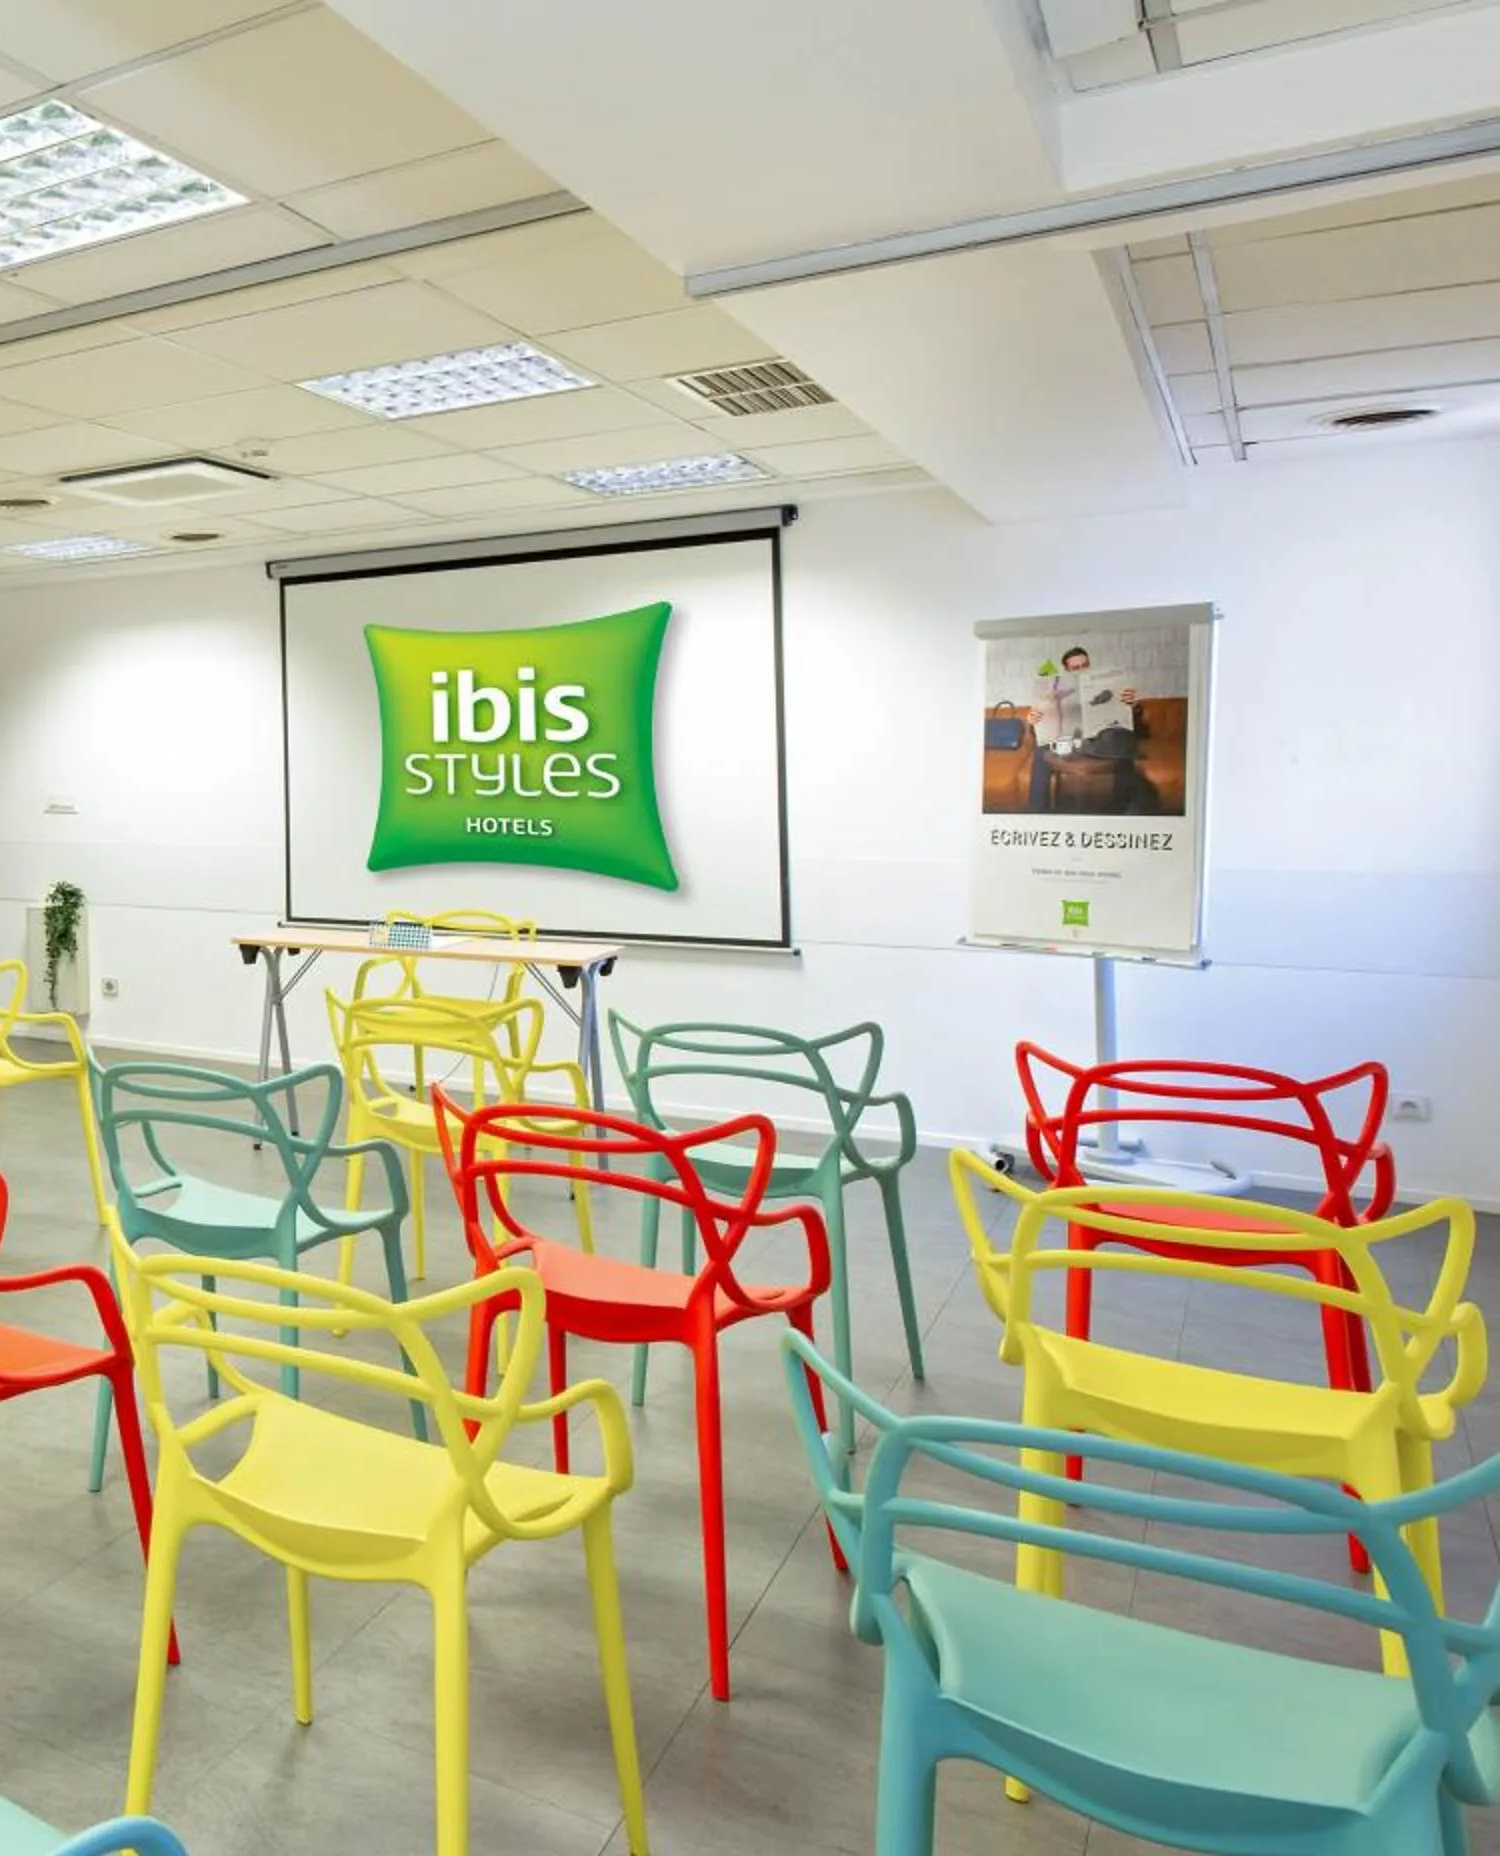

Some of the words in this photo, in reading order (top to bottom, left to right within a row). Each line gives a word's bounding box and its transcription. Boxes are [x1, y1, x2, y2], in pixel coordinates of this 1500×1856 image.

[431, 666, 589, 743] ibis
[405, 752, 621, 798] STYLES
[466, 817, 554, 836] HOTELS
[1065, 831, 1076, 847] &
[1081, 832, 1174, 851] DESSINEZ
